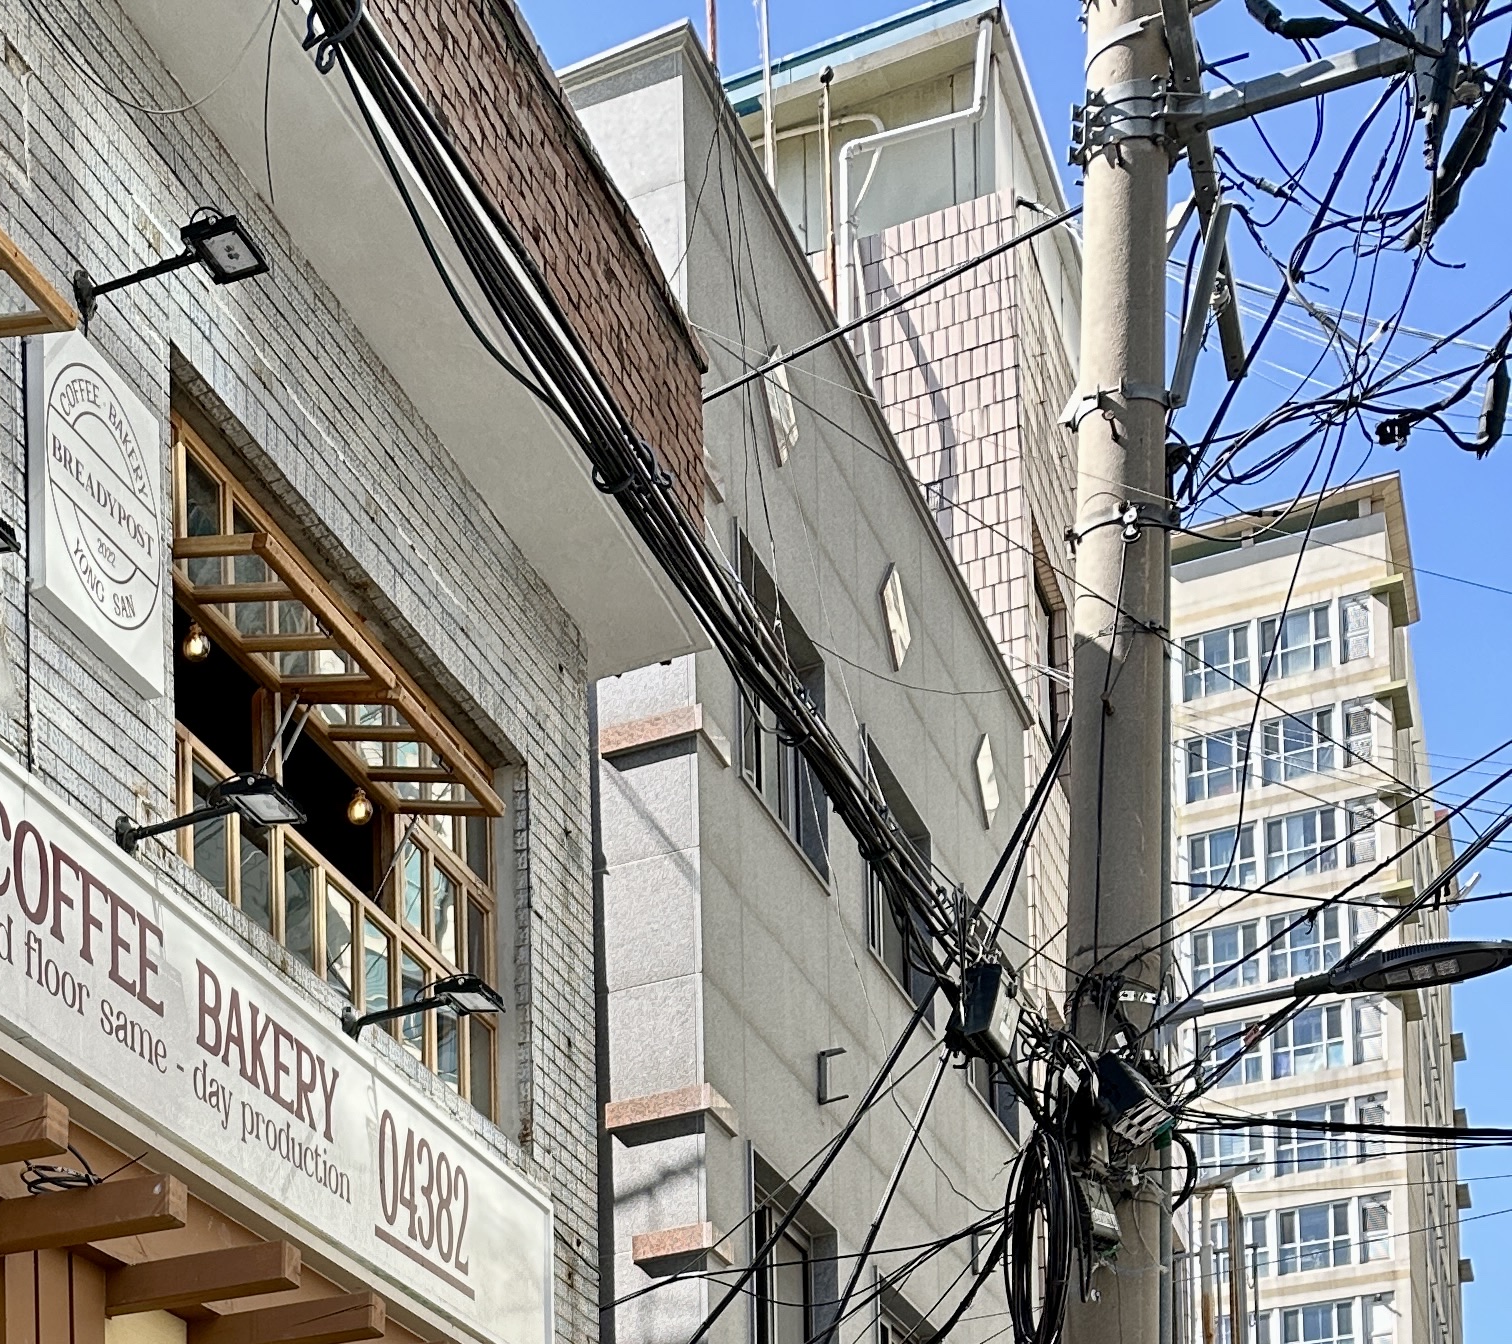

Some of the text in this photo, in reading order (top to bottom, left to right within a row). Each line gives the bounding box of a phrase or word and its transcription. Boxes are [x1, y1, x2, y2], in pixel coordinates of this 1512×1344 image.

[51, 433, 155, 559] BREADYPOST
[60, 378, 149, 498] COFFEE BAKERY
[72, 537, 136, 619] YONG SAN
[25, 929, 91, 1019] floor
[100, 997, 168, 1075] same
[193, 1058, 234, 1130] day
[240, 1099, 352, 1206] production
[196, 957, 340, 1144] BAKERY
[377, 1108, 470, 1277] 04382
